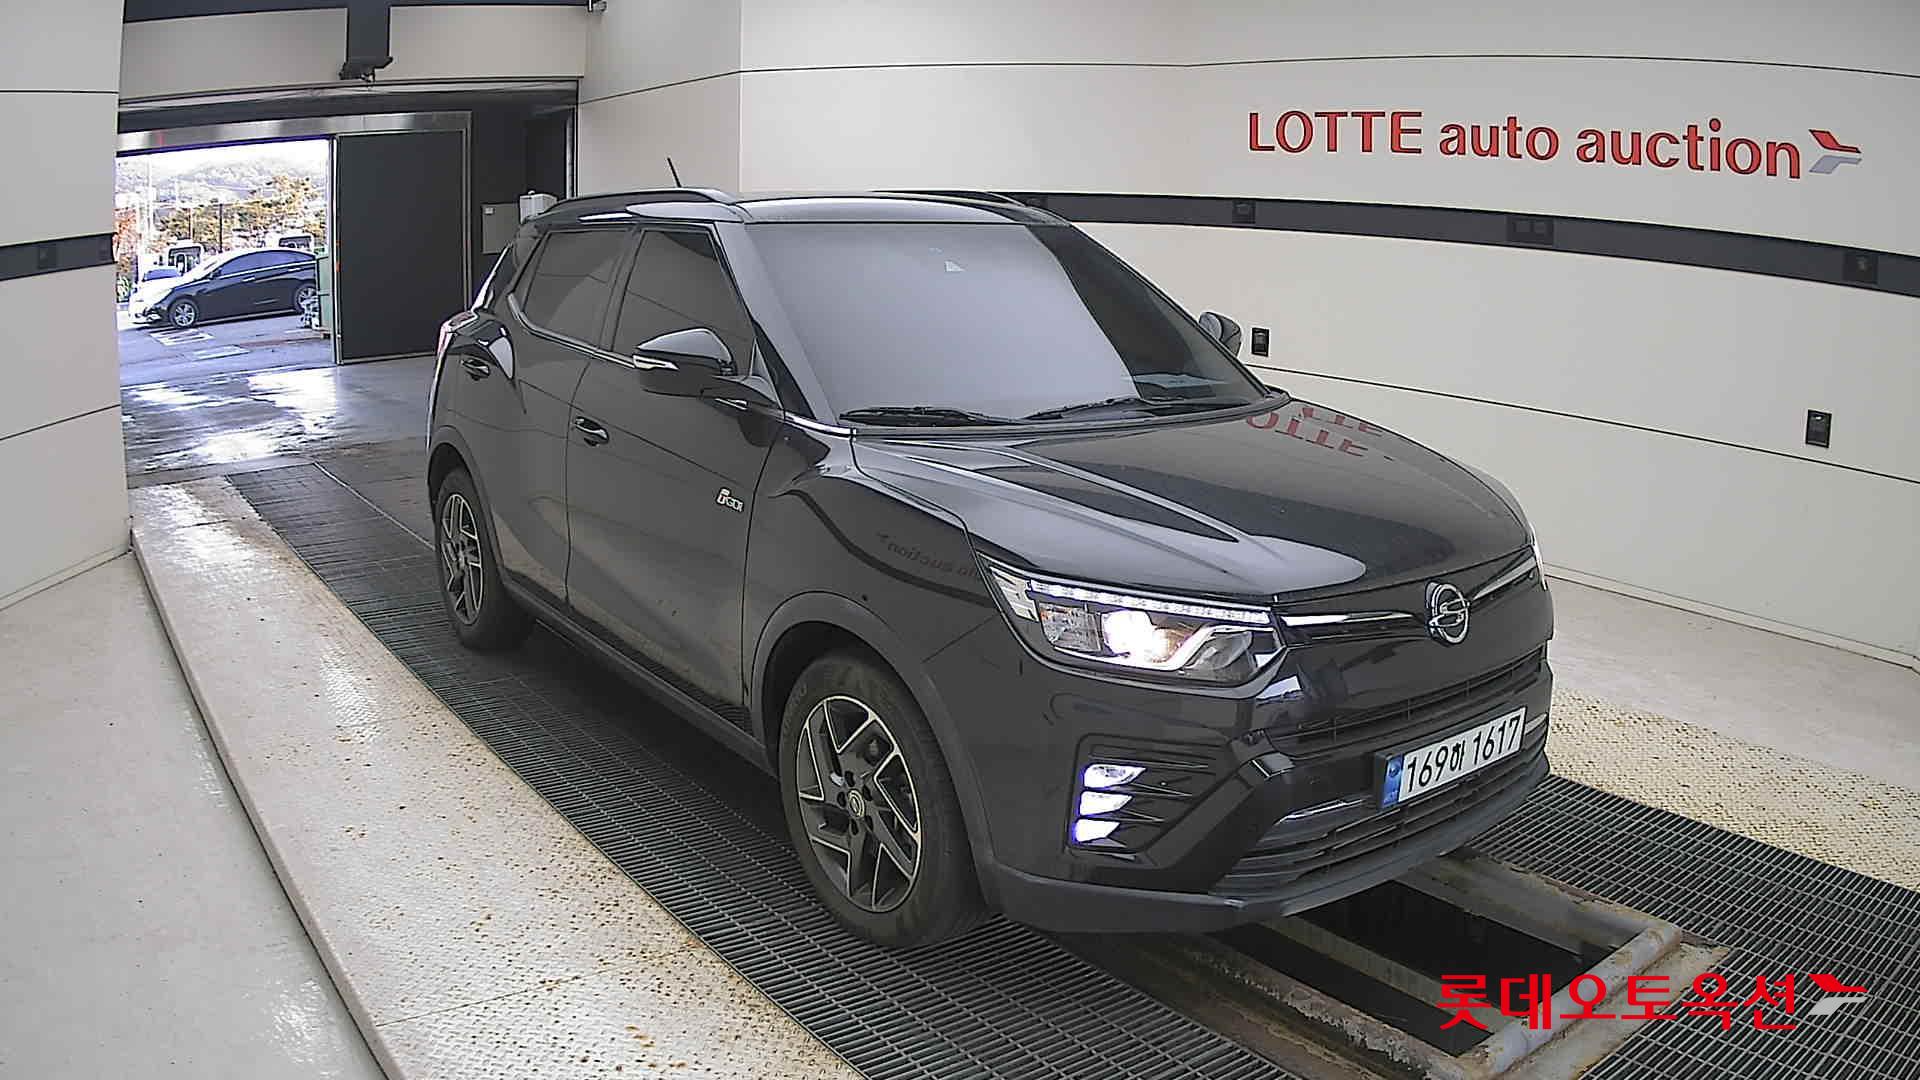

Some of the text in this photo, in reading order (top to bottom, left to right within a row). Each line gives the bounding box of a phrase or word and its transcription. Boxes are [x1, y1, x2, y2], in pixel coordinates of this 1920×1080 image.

[1248, 111, 1801, 179] LOTTE auto auction
[1472, 715, 1521, 765] 1617
